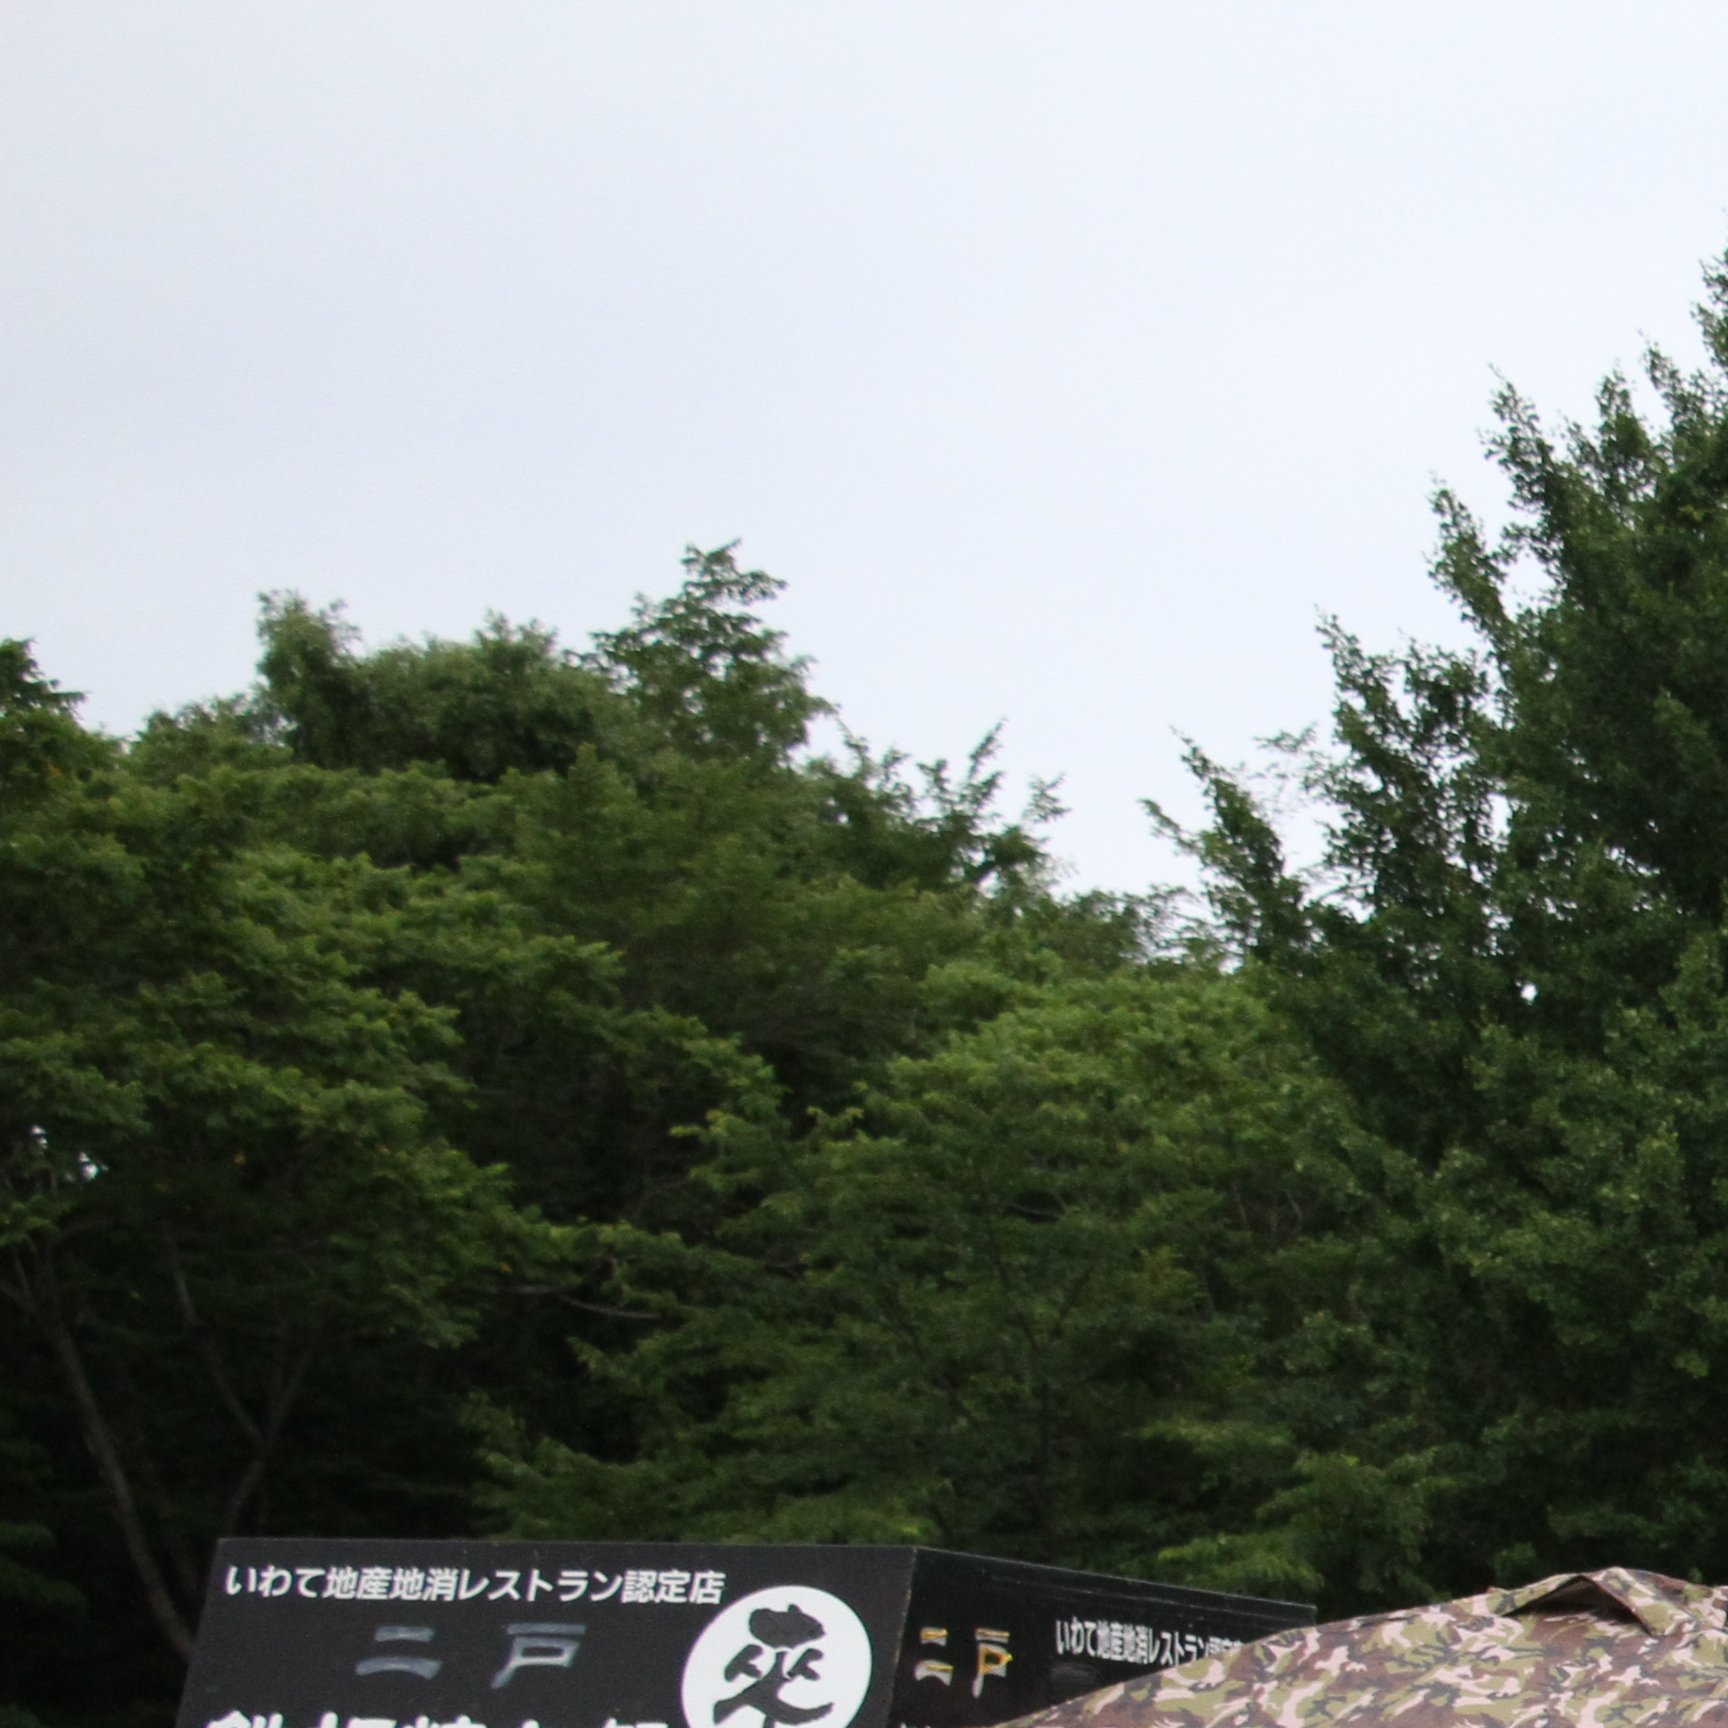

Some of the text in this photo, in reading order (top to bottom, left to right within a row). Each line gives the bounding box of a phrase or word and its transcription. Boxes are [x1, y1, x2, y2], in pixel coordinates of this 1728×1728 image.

[225, 1566, 726, 1605] いわて地産地消レストラン認定店
[355, 1622, 587, 1690] 二戸
[914, 1626, 1013, 1699] 二戸
